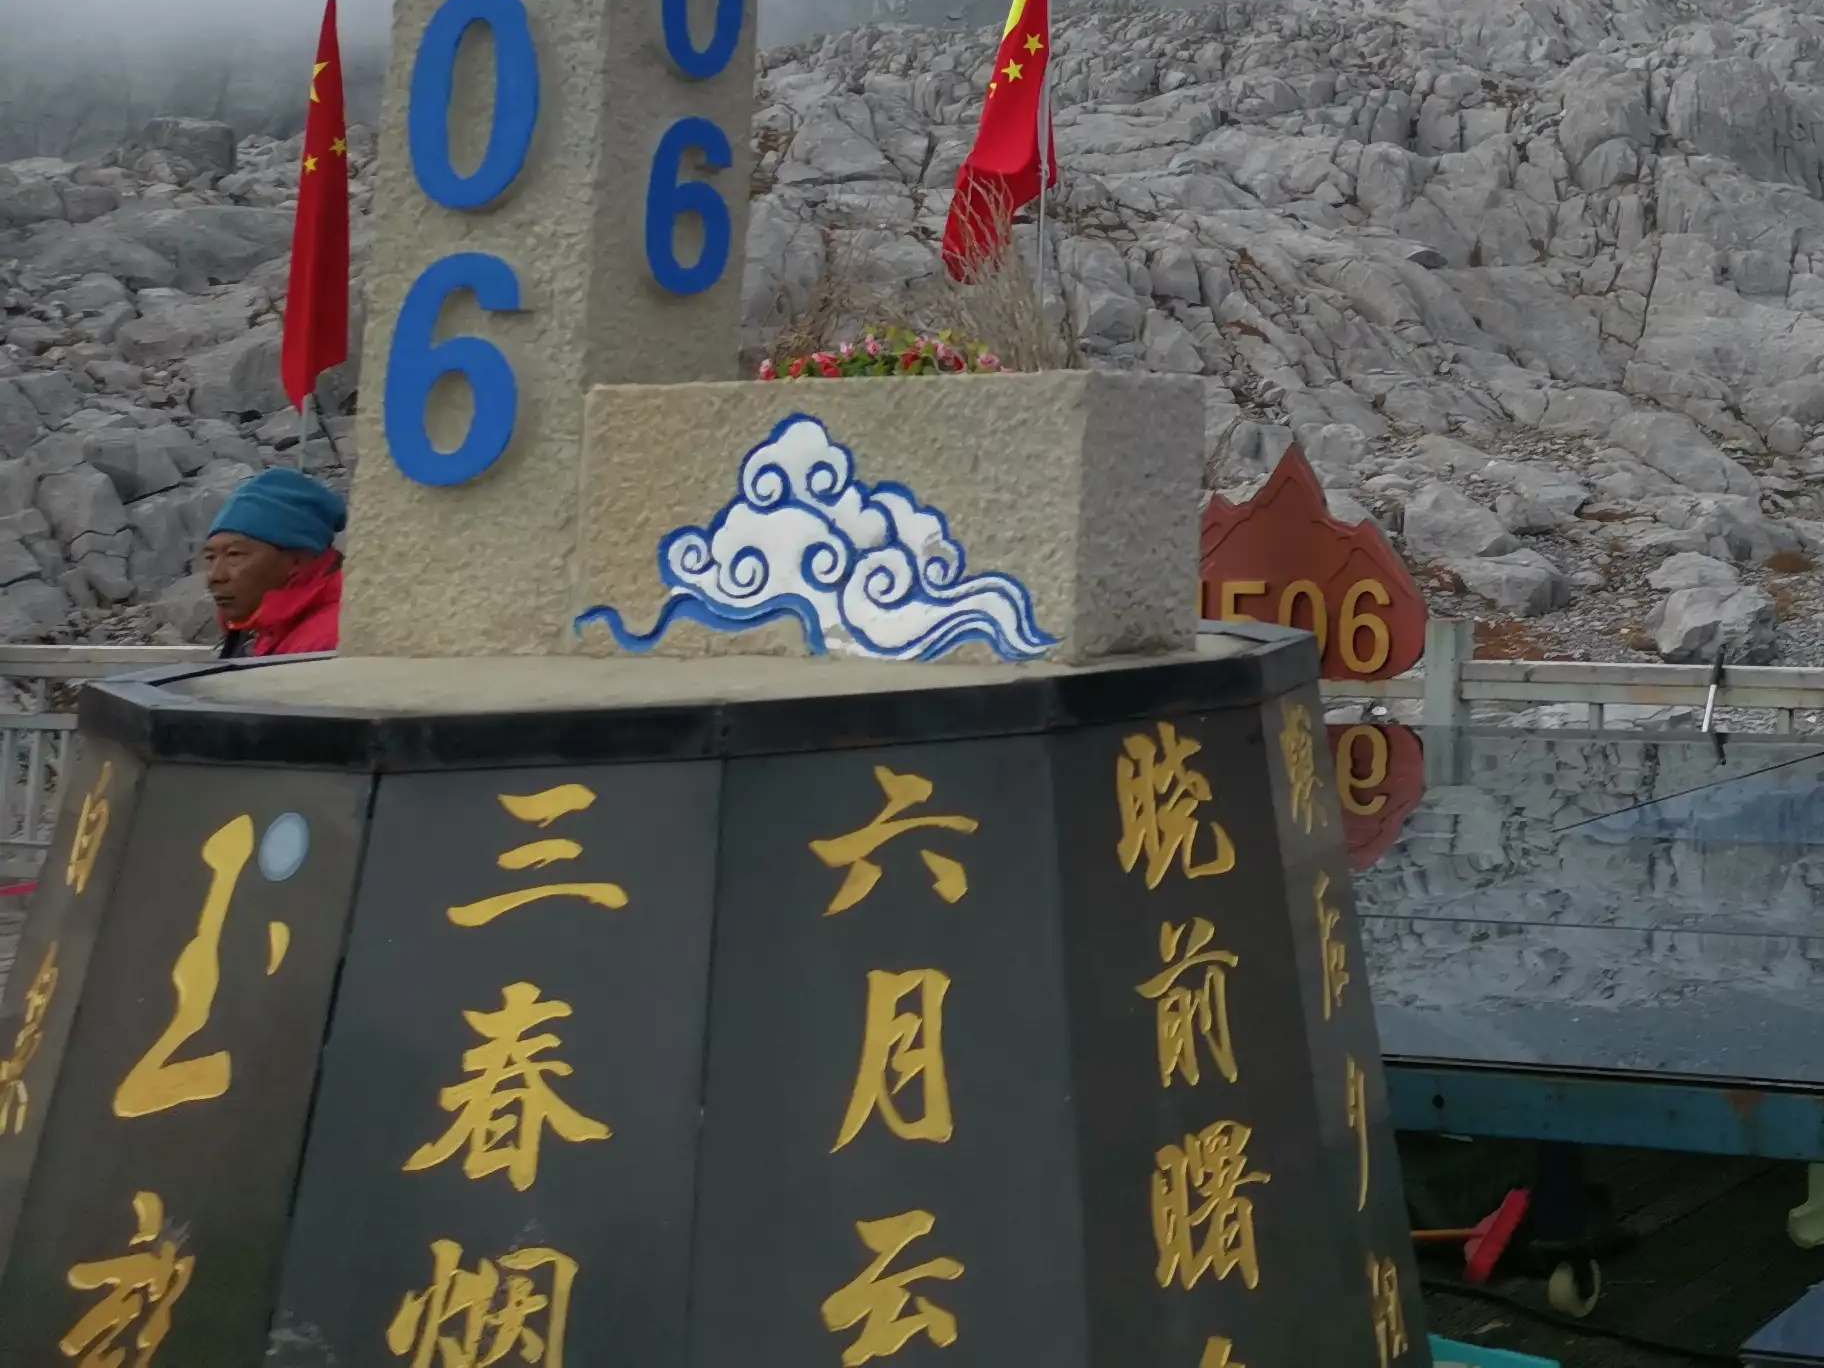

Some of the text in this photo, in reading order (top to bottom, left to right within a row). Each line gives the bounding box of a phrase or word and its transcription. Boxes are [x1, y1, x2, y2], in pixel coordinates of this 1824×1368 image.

[384, 783, 629, 1368] 三春烟
[809, 765, 979, 1368] 六月云
[1115, 721, 1272, 1368] 晓前曙
